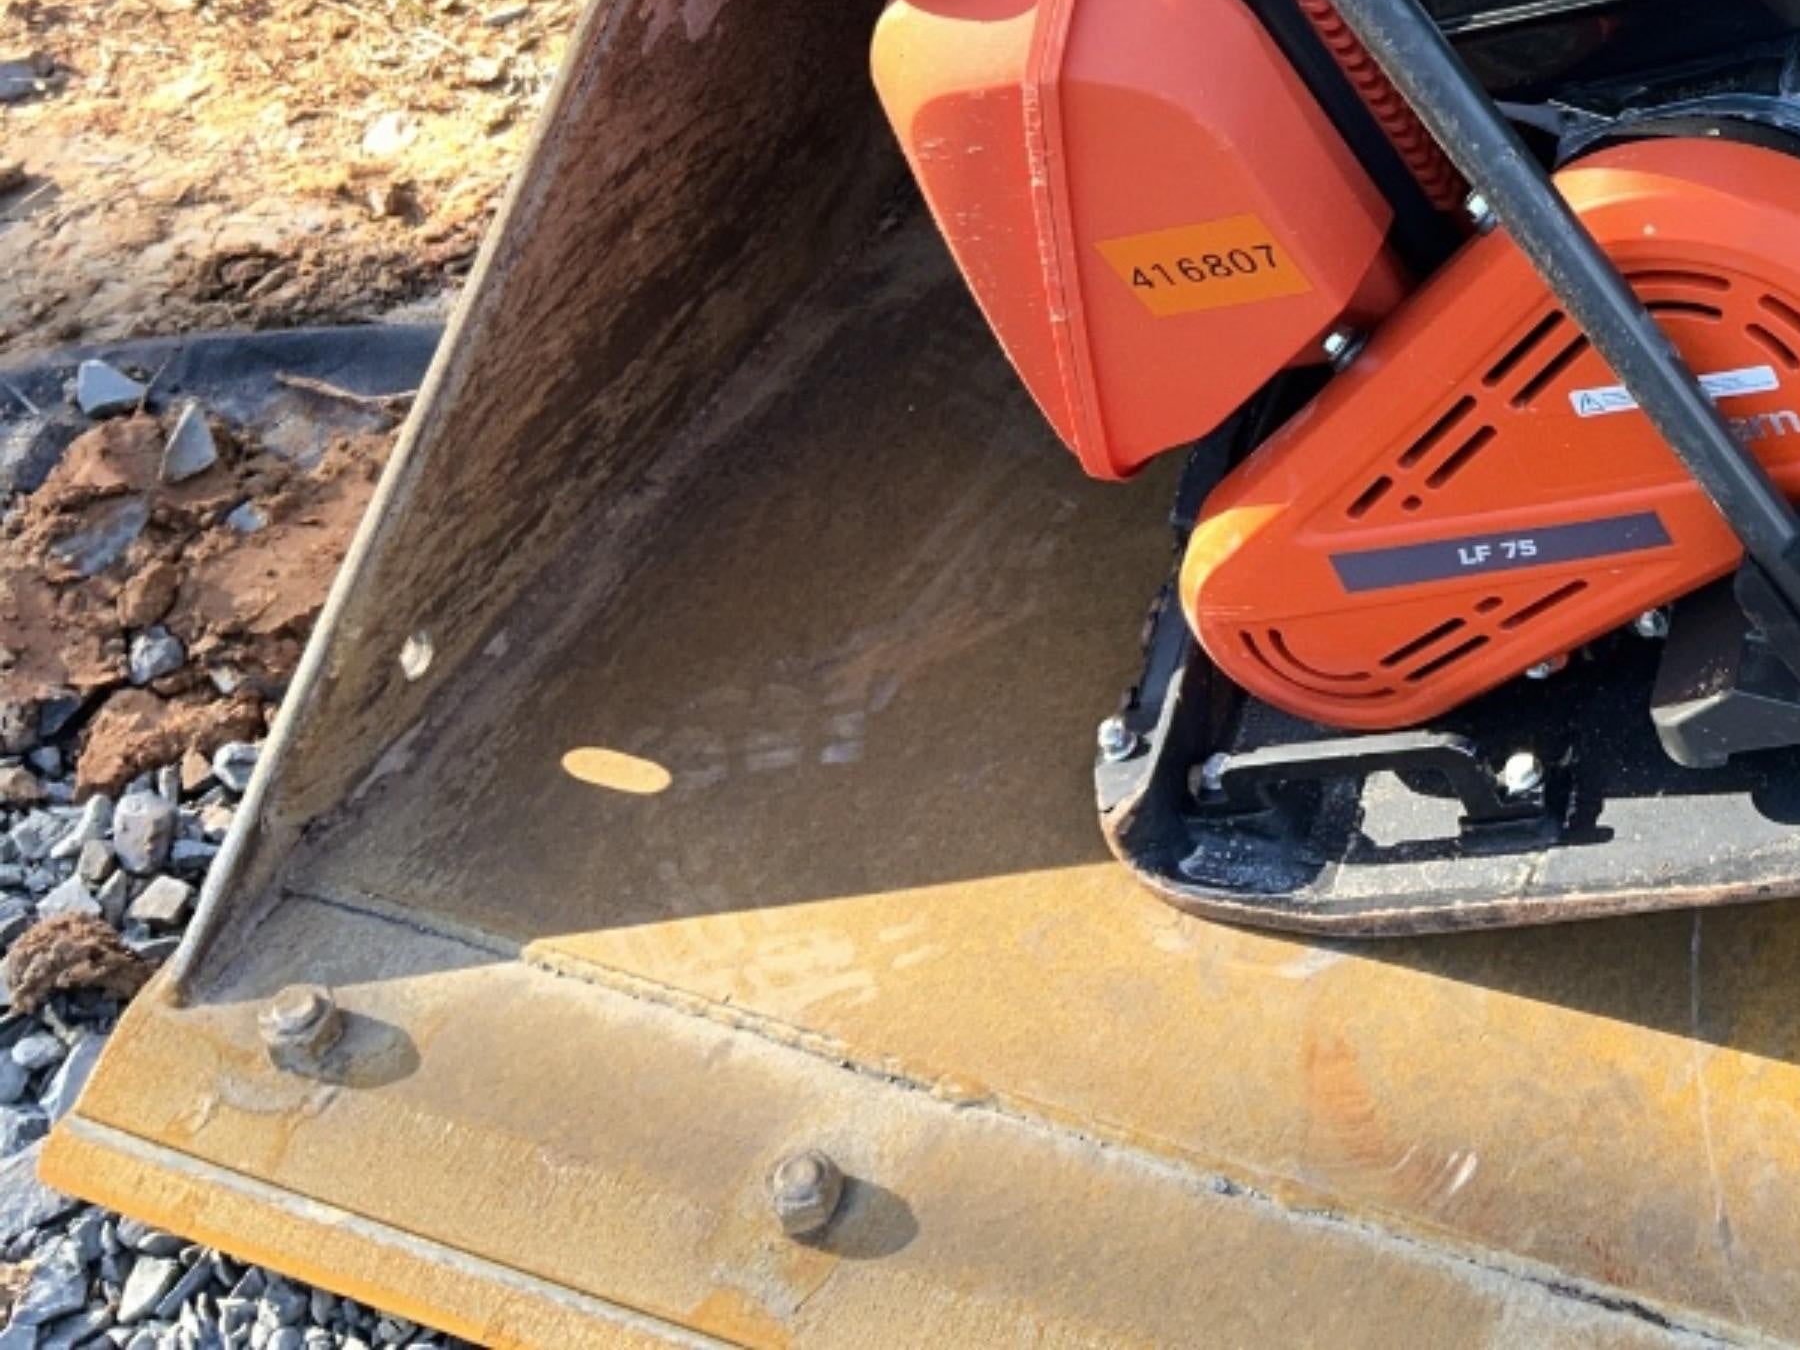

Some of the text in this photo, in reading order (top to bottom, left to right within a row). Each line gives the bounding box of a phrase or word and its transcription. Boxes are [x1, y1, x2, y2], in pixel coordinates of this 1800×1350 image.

[1132, 243, 1277, 289] 416807
[1457, 539, 1537, 565] LF 75
